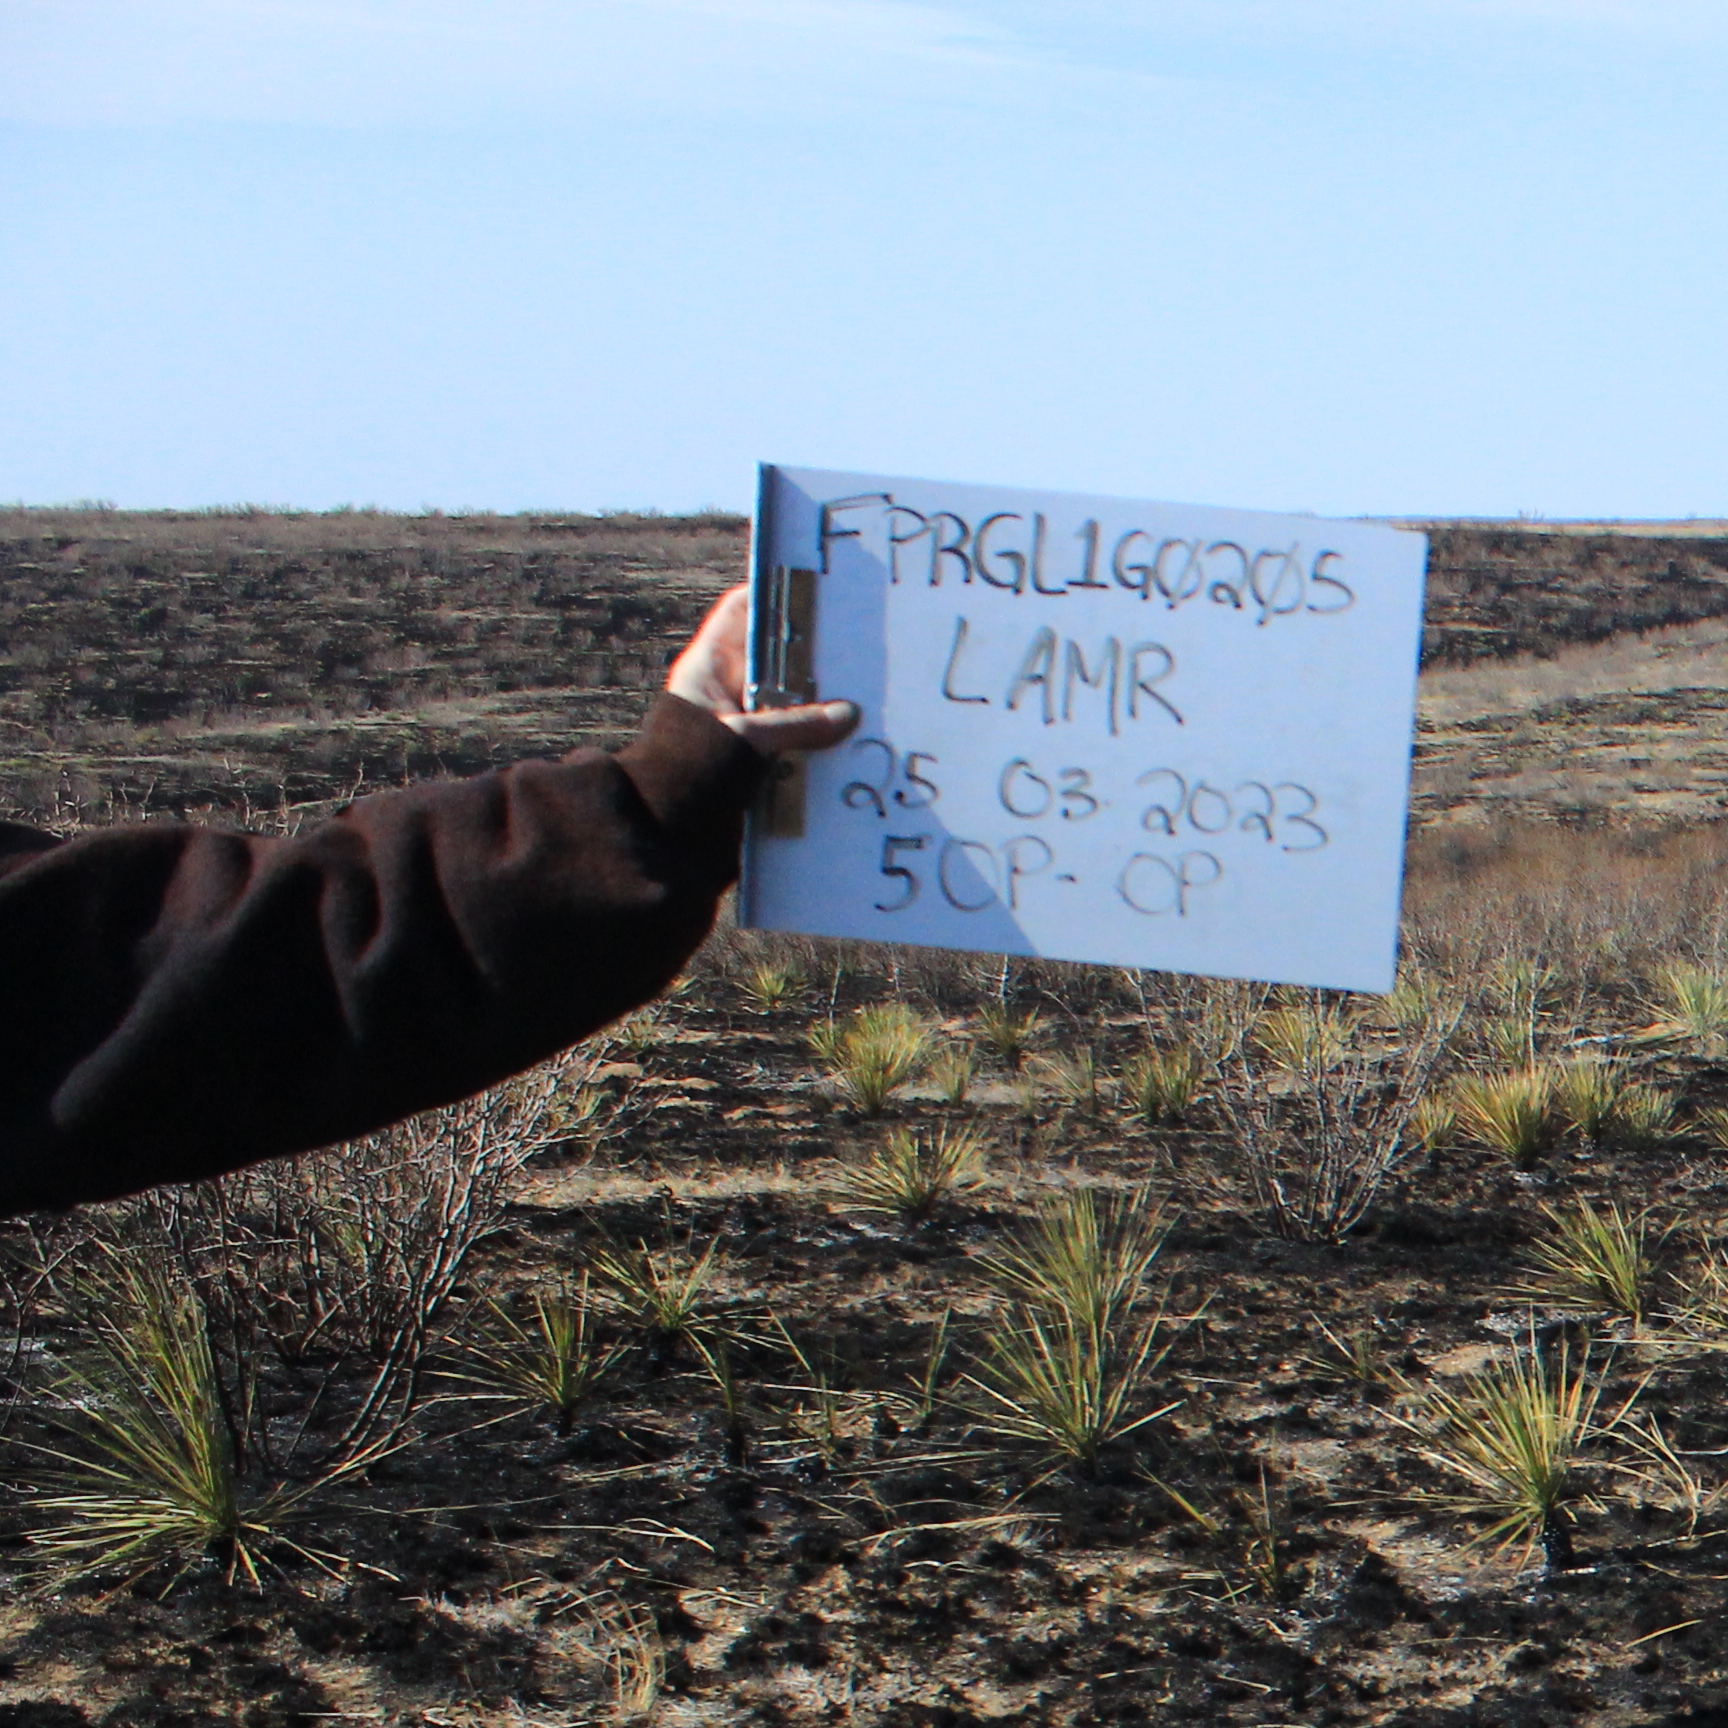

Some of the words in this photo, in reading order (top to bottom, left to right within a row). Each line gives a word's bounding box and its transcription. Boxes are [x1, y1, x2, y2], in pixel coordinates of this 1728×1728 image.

[940, 614, 1186, 737] LAMR
[841, 737, 941, 819] 25
[999, 756, 1099, 820] 03
[1135, 767, 1330, 854] 2023
